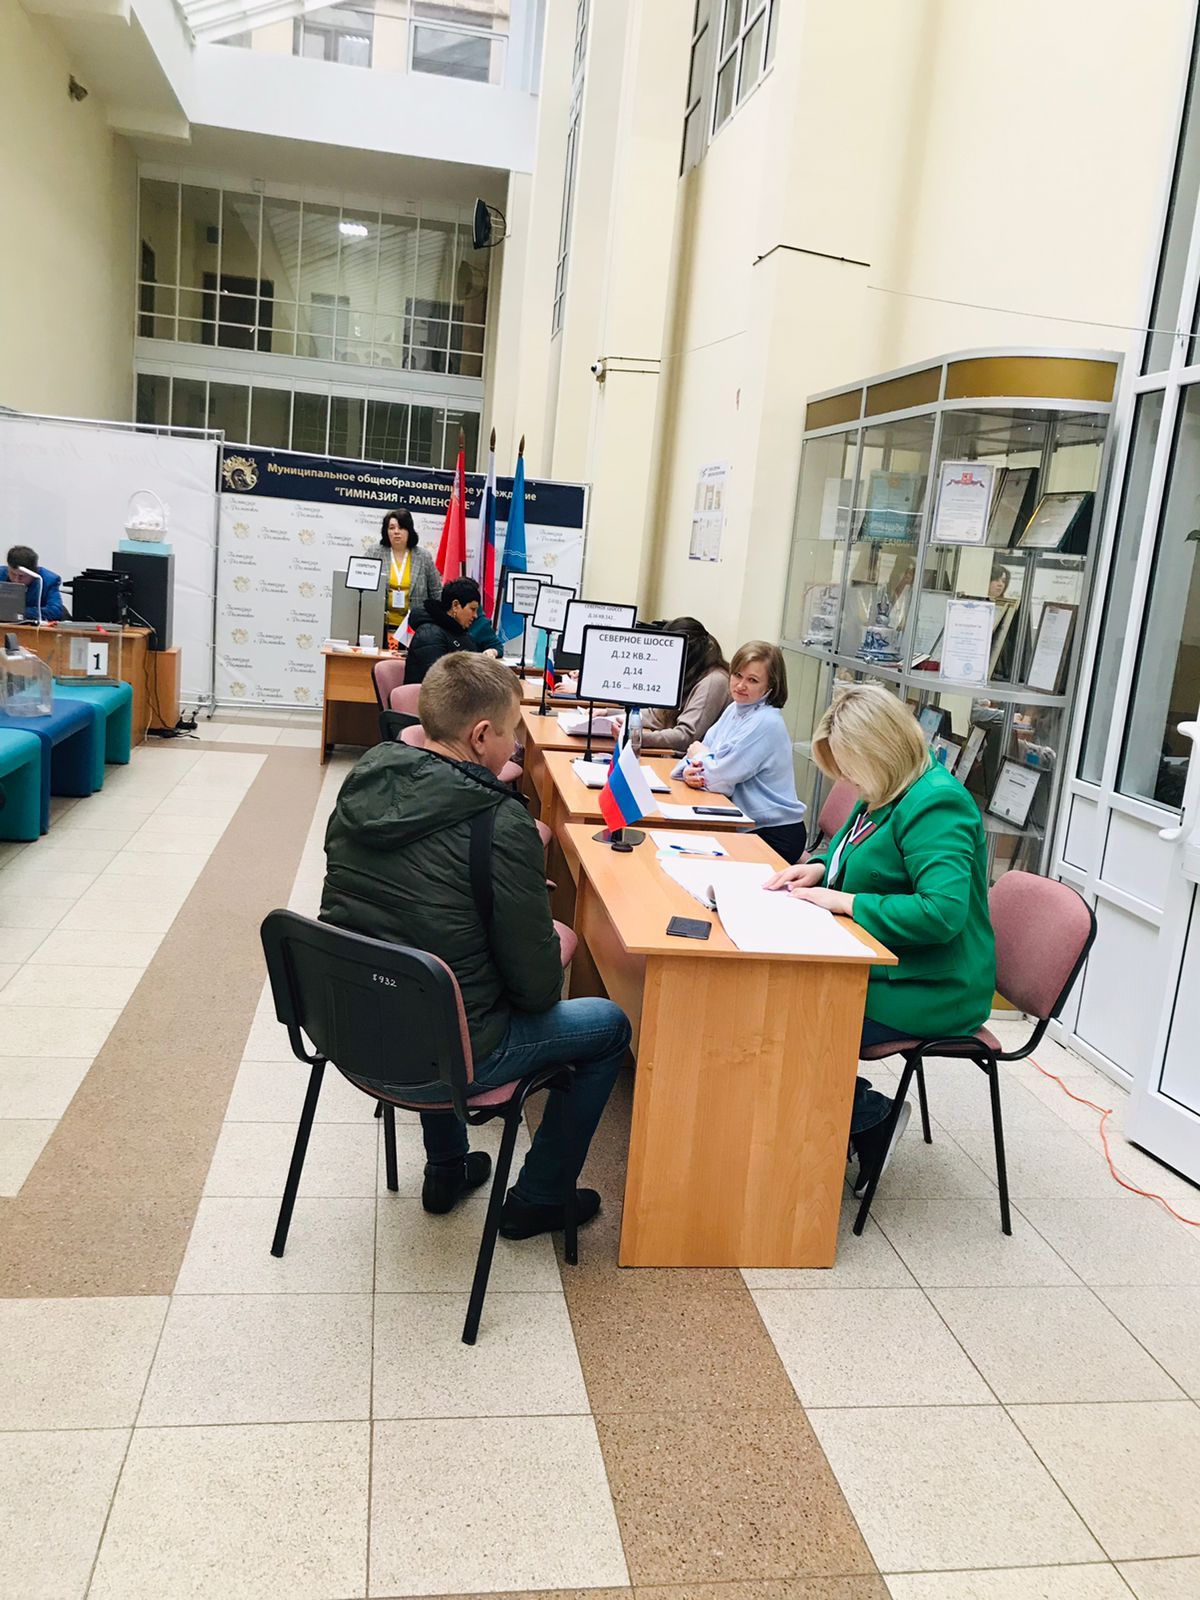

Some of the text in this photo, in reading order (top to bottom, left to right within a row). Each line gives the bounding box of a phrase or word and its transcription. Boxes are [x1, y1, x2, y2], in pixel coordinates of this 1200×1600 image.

[267, 463, 355, 481] Муниципальное
[408, 495, 475, 510] РАМЕНСЕ”
[599, 634, 674, 647] СЕВЕРНОЕ ШОССЕ
[611, 650, 631, 659] Д.12
[93, 653, 101, 670] 1
[623, 666, 643, 675] Д.14
[602, 680, 622, 689] Д.16
[632, 683, 661, 692] КВ.142
